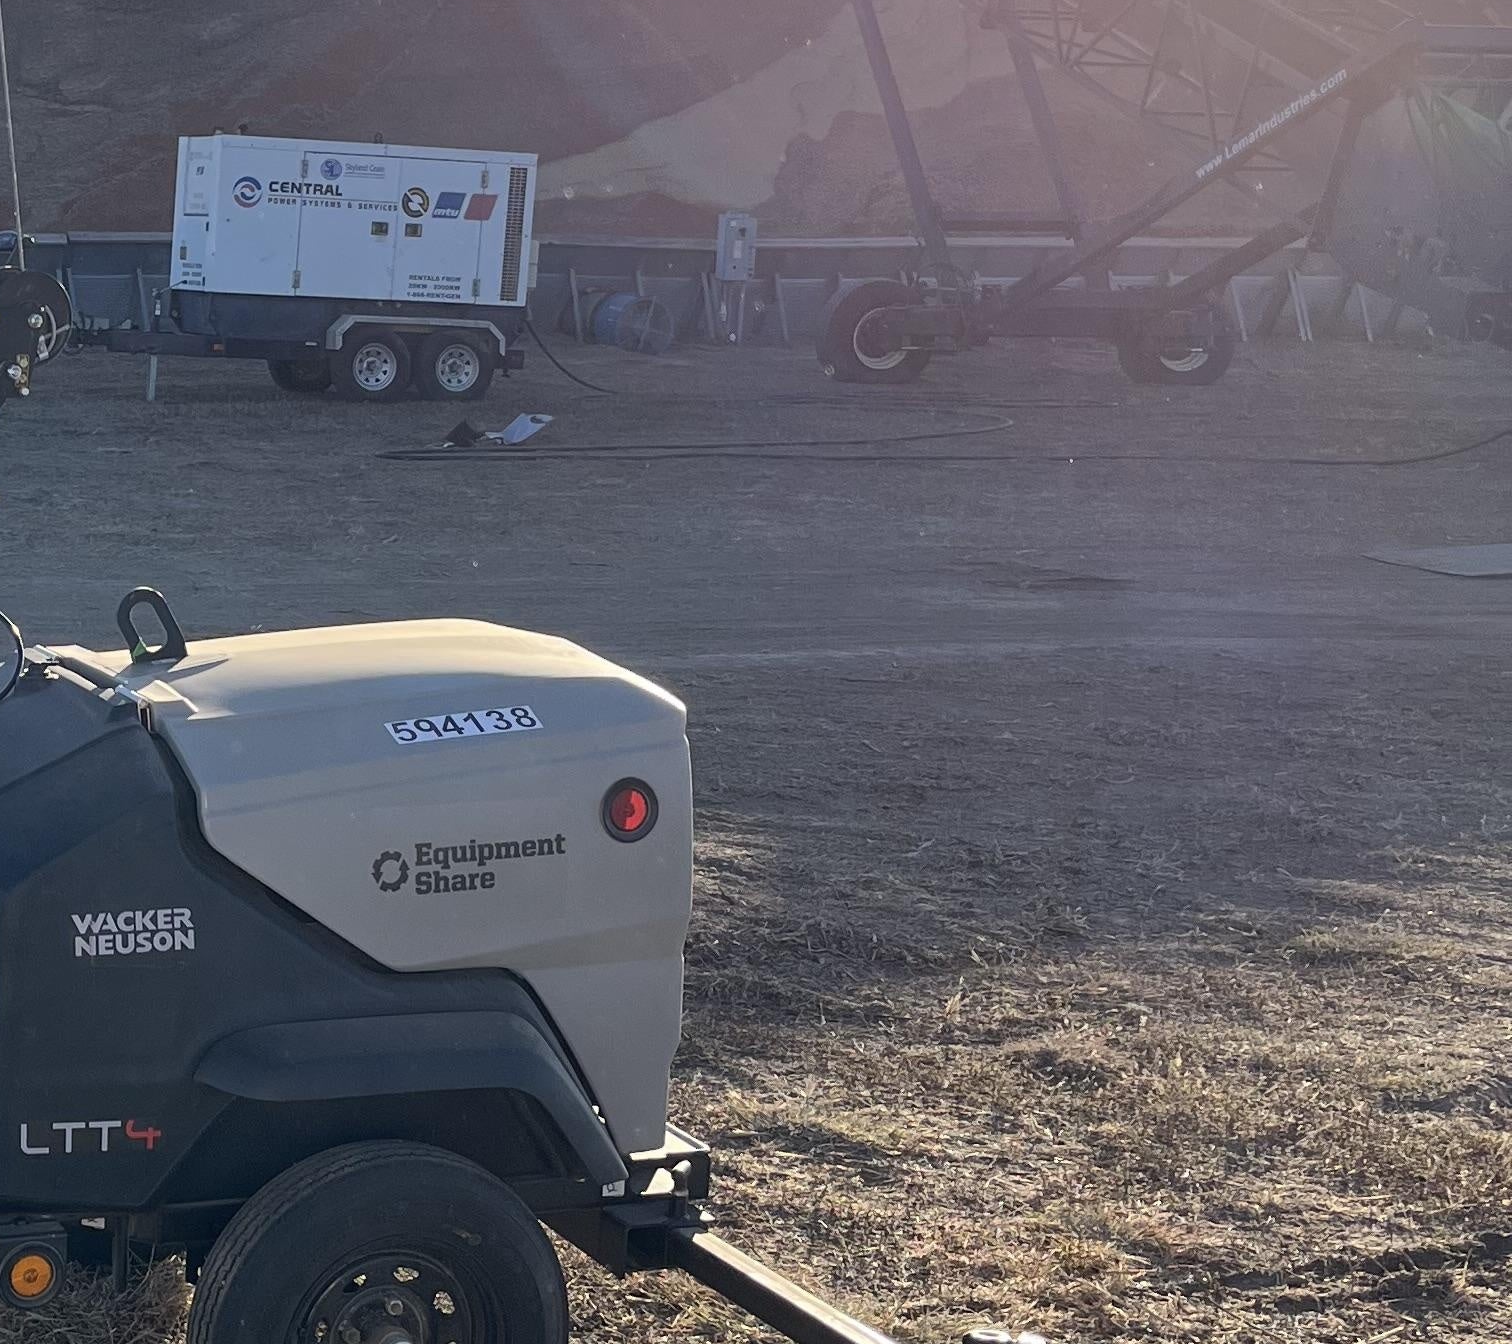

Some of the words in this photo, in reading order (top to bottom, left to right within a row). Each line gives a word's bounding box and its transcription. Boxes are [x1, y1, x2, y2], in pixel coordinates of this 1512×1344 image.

[268, 180, 343, 197] CENTRAL
[268, 197, 297, 206] POWER
[302, 199, 342, 209] SYSTEMS
[357, 202, 398, 212] SERVICES
[434, 208, 460, 217] mtu
[391, 707, 537, 742] 594138
[414, 834, 566, 870] Equipment
[415, 871, 496, 895] Share
[71, 907, 194, 935] WACKER
[74, 929, 195, 957] NEUSON
